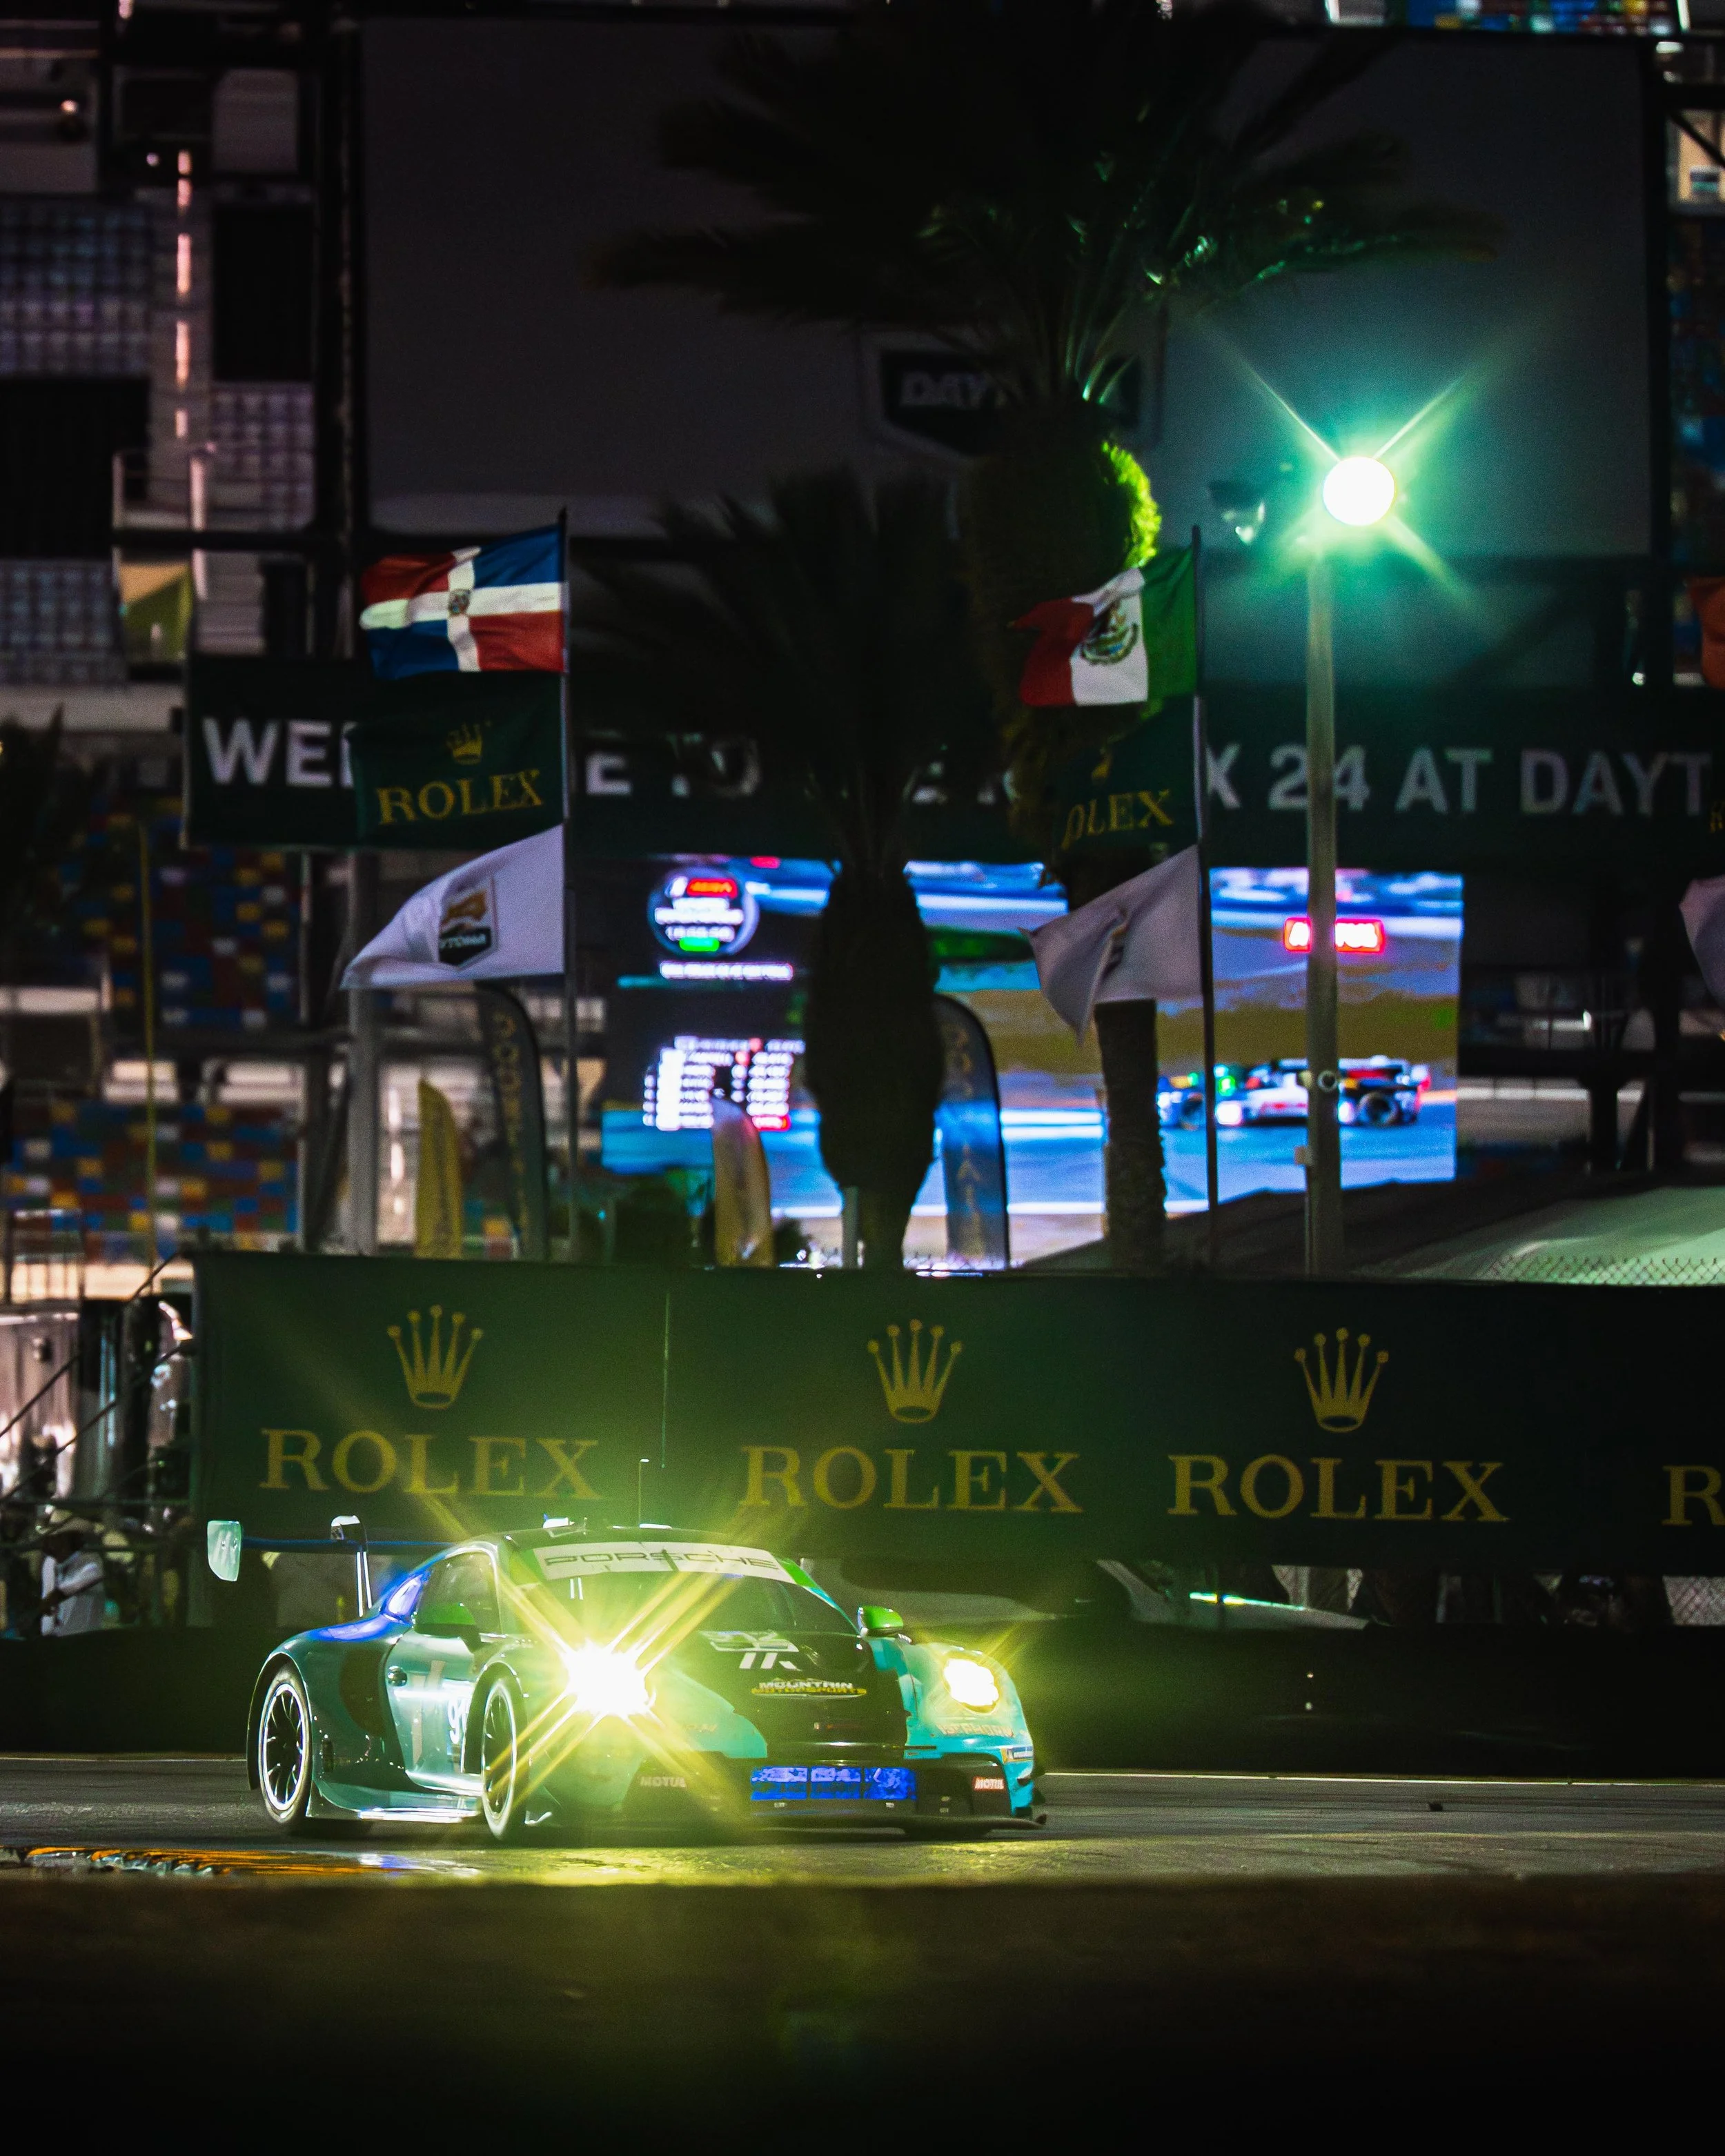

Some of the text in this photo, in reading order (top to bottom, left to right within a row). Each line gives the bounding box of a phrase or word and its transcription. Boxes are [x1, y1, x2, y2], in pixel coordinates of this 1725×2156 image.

[376, 769, 544, 825] ROLEX
[1267, 742, 1371, 811] 24
[1394, 745, 1493, 815] AT
[259, 1428, 604, 1500] ROLEX
[739, 1445, 1083, 1513] ROLEX
[1166, 1454, 1511, 1522] ROLEX
[544, 1552, 779, 1571] PORSCHE
[640, 1777, 687, 1788] MOTUL
[974, 1777, 1005, 1790] MOTUL
